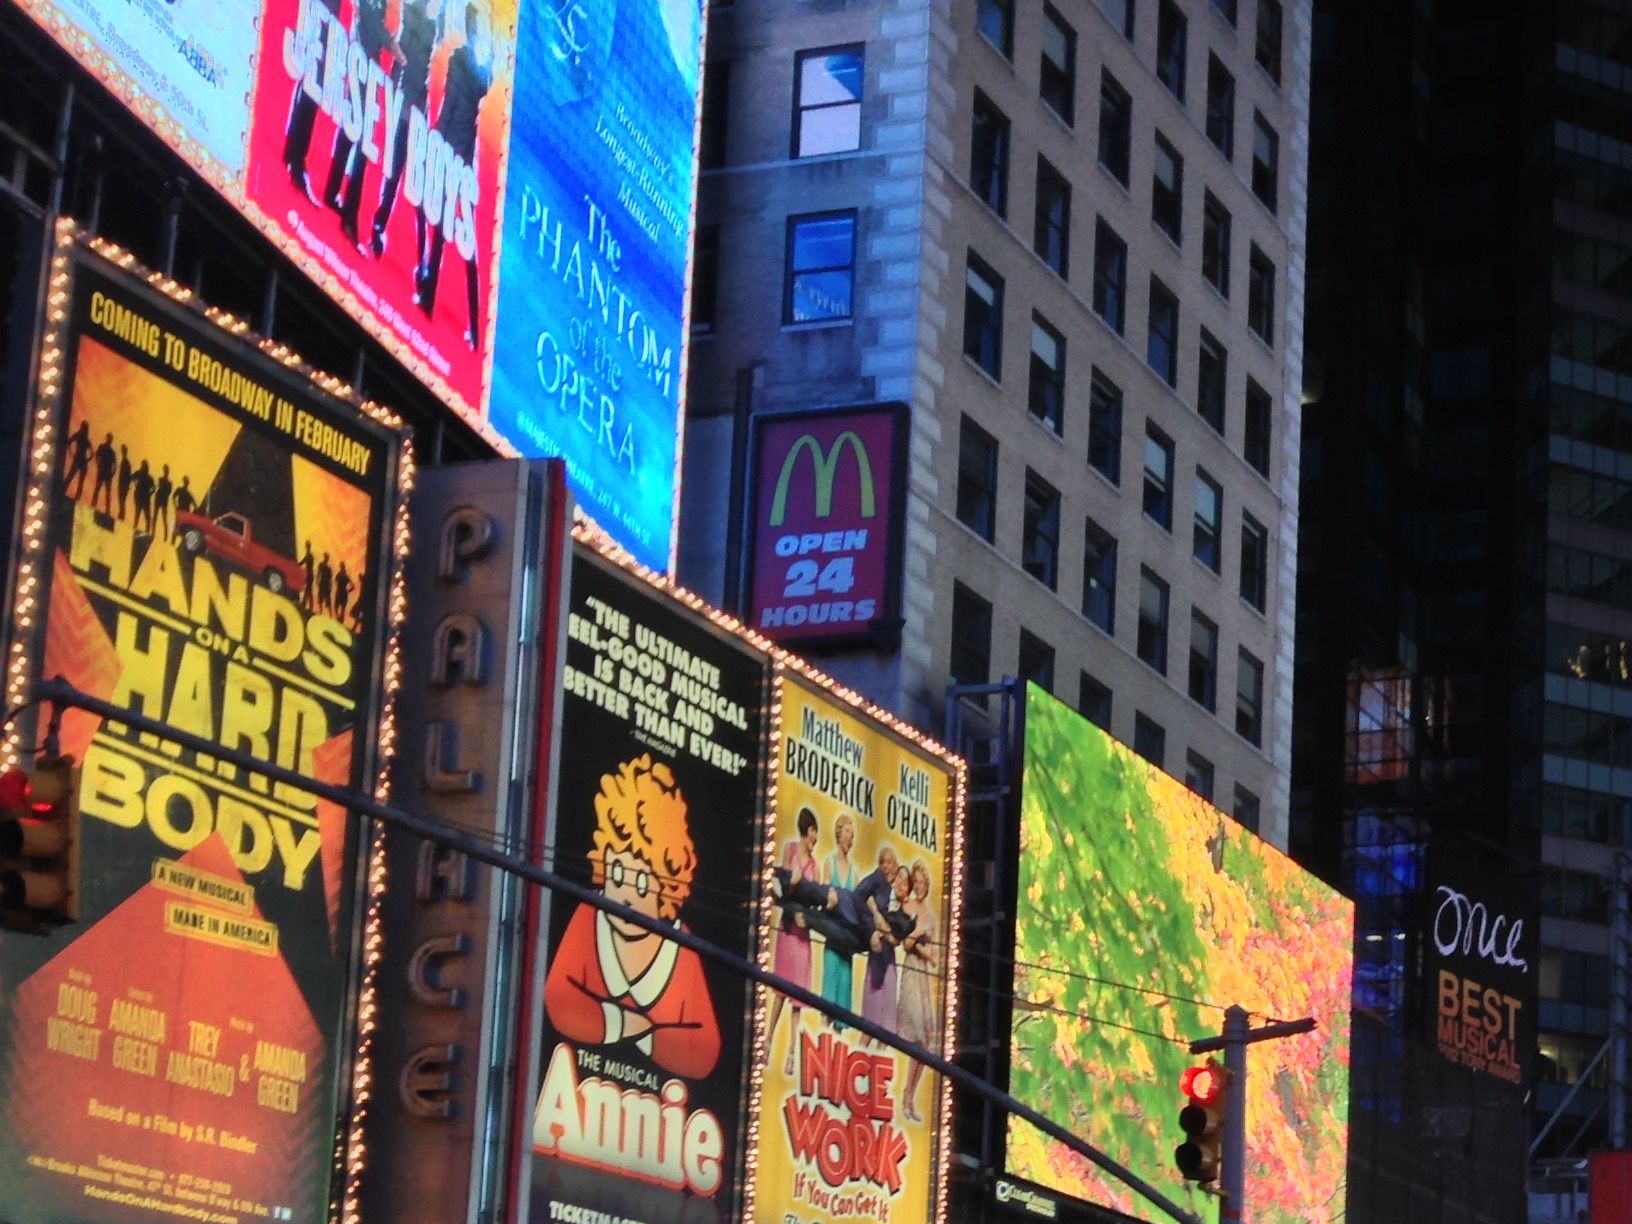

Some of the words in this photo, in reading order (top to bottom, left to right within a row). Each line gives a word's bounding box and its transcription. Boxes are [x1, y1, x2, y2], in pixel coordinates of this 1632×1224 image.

[283, 0, 404, 179] JERSEY
[404, 105, 480, 261] BOYS
[584, 193, 622, 273] The
[519, 185, 672, 398] PHANTOM
[90, 291, 160, 360] COMING
[164, 331, 184, 373] TO
[188, 347, 274, 428] BROADWAY
[277, 397, 293, 434] IN
[295, 410, 371, 476] FEBRUARY
[537, 332, 636, 476] OPERA
[775, 529, 868, 557] OPEN
[783, 556, 854, 598] 24
[69, 502, 353, 687] HANDS
[761, 599, 876, 628] HOURS
[195, 626, 229, 655] ON
[232, 645, 250, 664] A
[568, 612, 666, 685] EEL-GOOD
[671, 671, 748, 731] MUSICAL
[635, 624, 720, 690] ULTIMATE
[107, 610, 329, 811] HARD
[564, 665, 629, 720] BETTER
[634, 703, 684, 748] THAN
[594, 654, 613, 684] IS
[619, 668, 670, 714] BACK
[674, 701, 714, 737] AND
[786, 737, 875, 819] BRODERICK
[801, 706, 864, 769] Matthew
[79, 743, 322, 891] BODY
[887, 794, 937, 853] O'HARA
[900, 763, 930, 808] Kelli
[168, 871, 195, 893] NEW
[197, 879, 246, 906] MUSICAL
[1434, 886, 1528, 973] Once
[207, 916, 221, 934] IN
[222, 919, 272, 948] AMERICA
[1437, 1014, 1518, 1067] MUSICAL
[1439, 969, 1522, 1041] BEST
[577, 1048, 600, 1072] THE
[604, 1060, 659, 1091] MUSICAL
[800, 1029, 894, 1122] NICE
[532, 1042, 725, 1198] Annie
[784, 1093, 909, 1195] WORK
[794, 1171, 805, 1198] If
[807, 1179, 829, 1211] You
[831, 1192, 854, 1217] Can
[856, 1193, 878, 1216] Get
[877, 1199, 890, 1224] It
